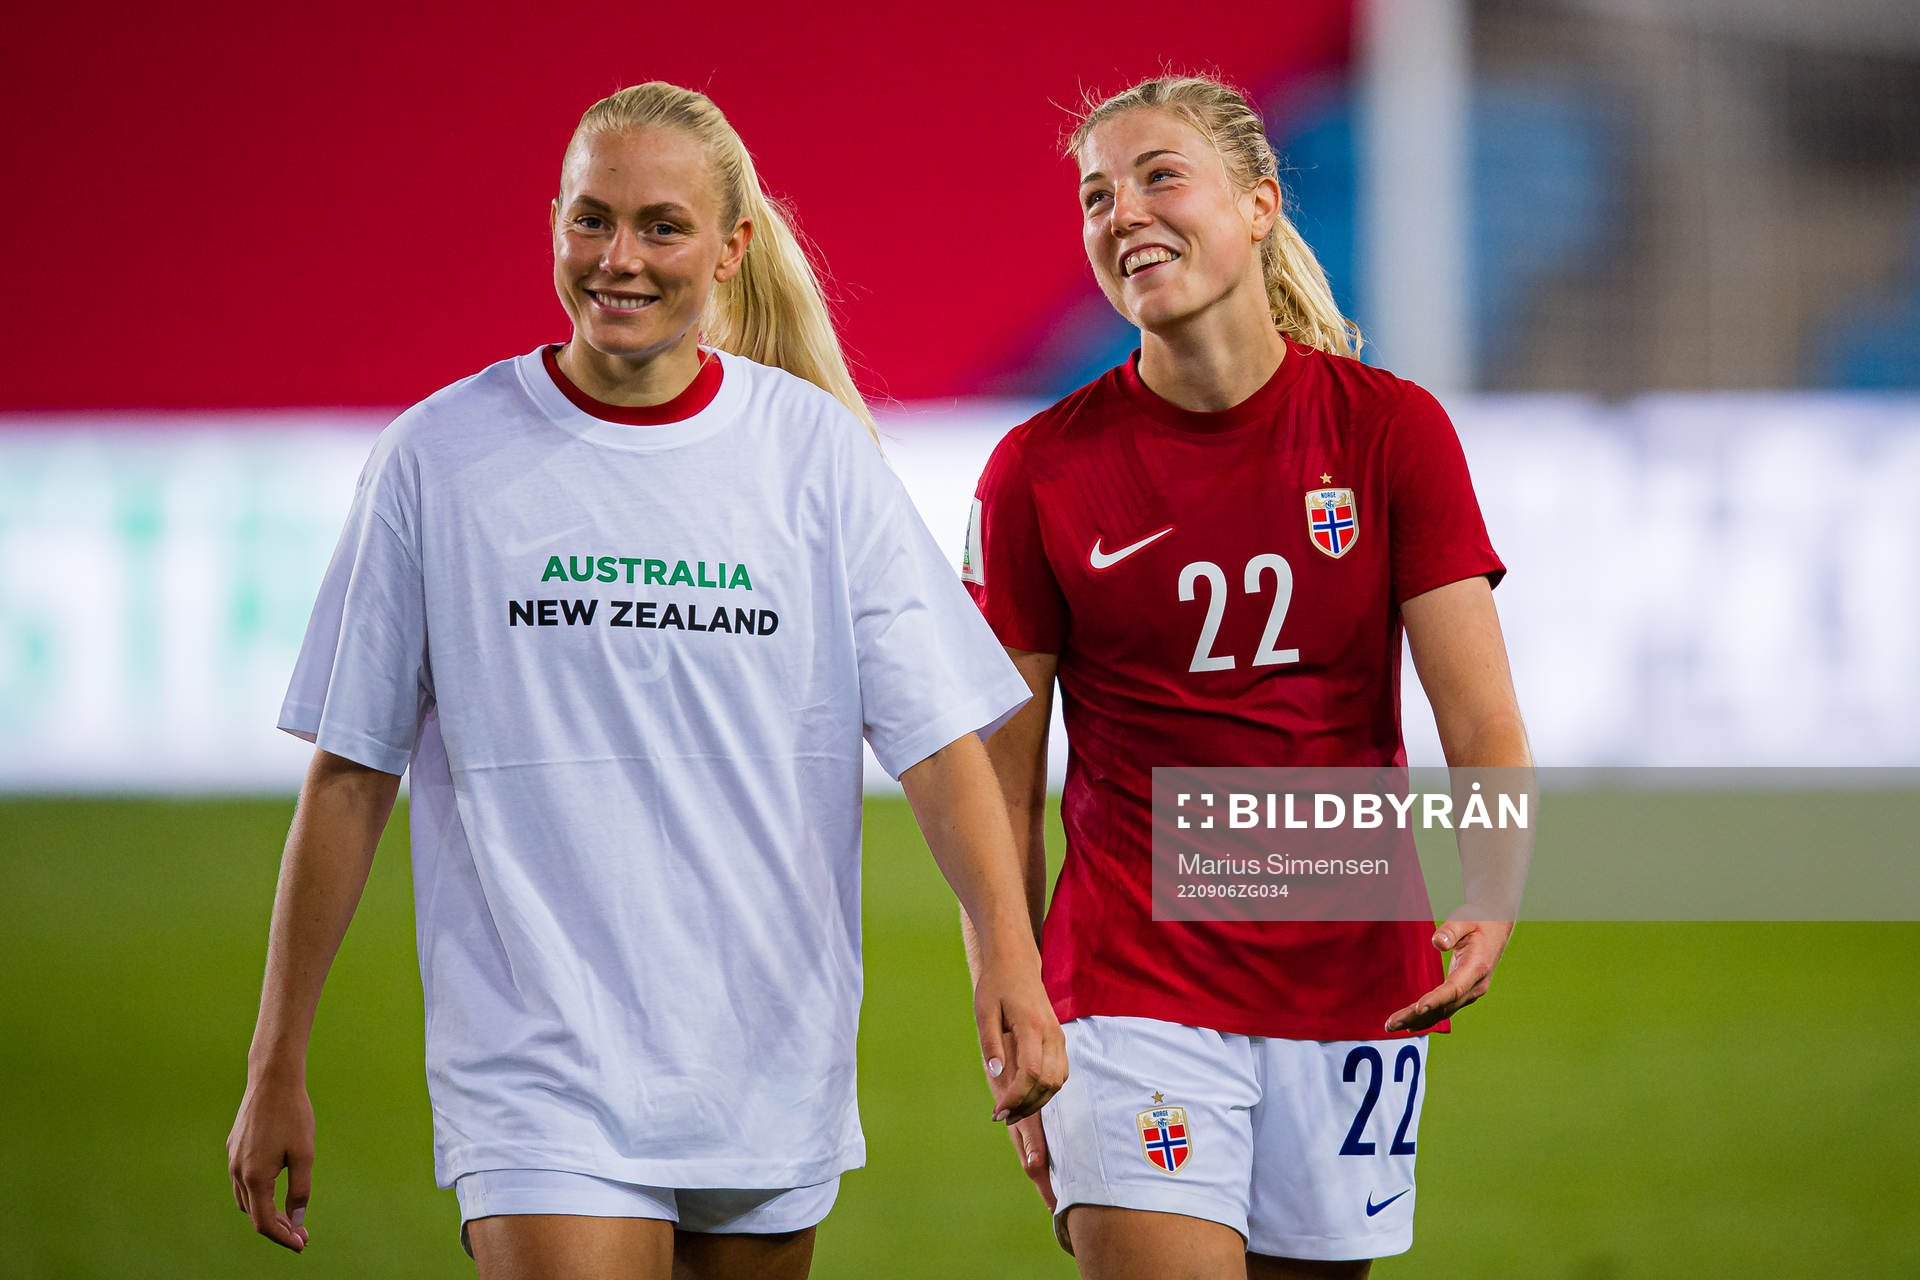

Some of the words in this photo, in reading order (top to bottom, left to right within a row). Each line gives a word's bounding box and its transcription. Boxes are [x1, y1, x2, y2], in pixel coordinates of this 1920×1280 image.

[541, 555, 753, 591] AUSTRALIA
[508, 599, 599, 627] NEW
[610, 600, 779, 636] ZEALAND
[1178, 553, 1299, 672] 22
[1338, 1044, 1421, 1156] 22
